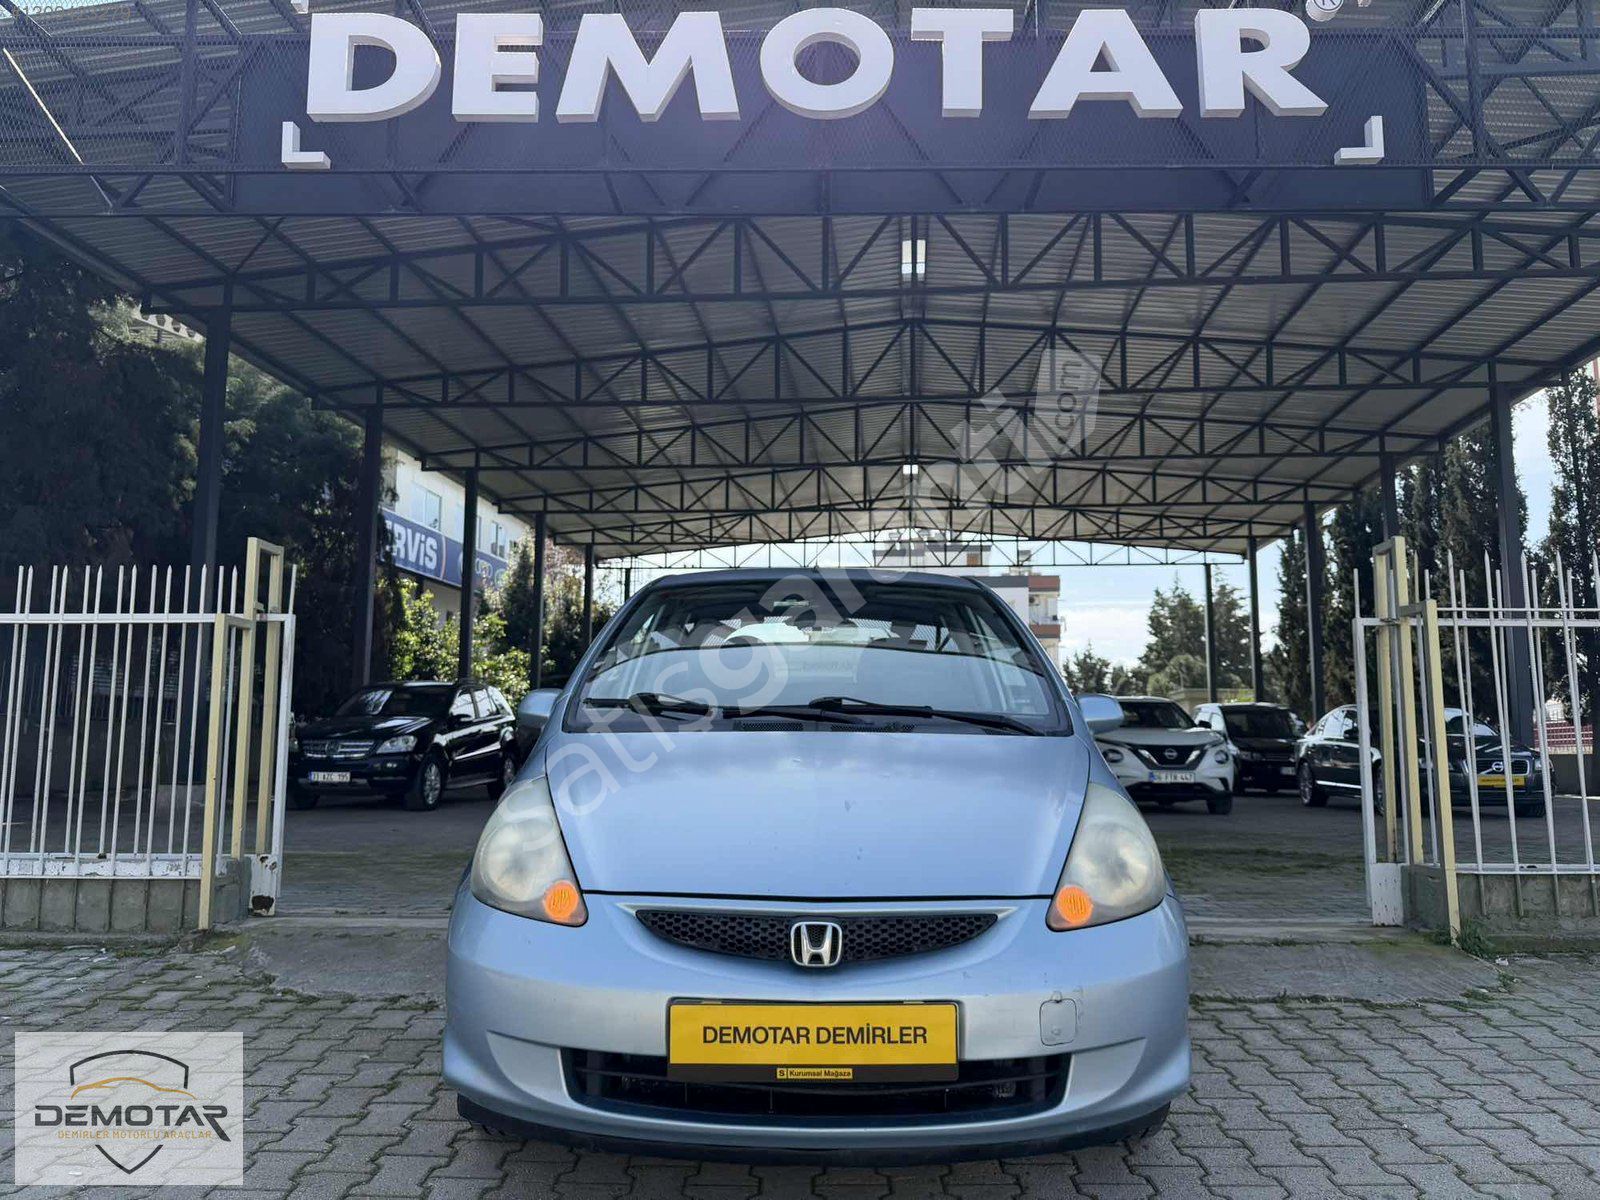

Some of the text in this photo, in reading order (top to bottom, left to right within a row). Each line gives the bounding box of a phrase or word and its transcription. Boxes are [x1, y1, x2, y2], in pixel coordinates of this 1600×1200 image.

[305, 8, 1328, 124] DEMOTAR
[702, 1022, 928, 1045] DEMOTAR DEMİRLER
